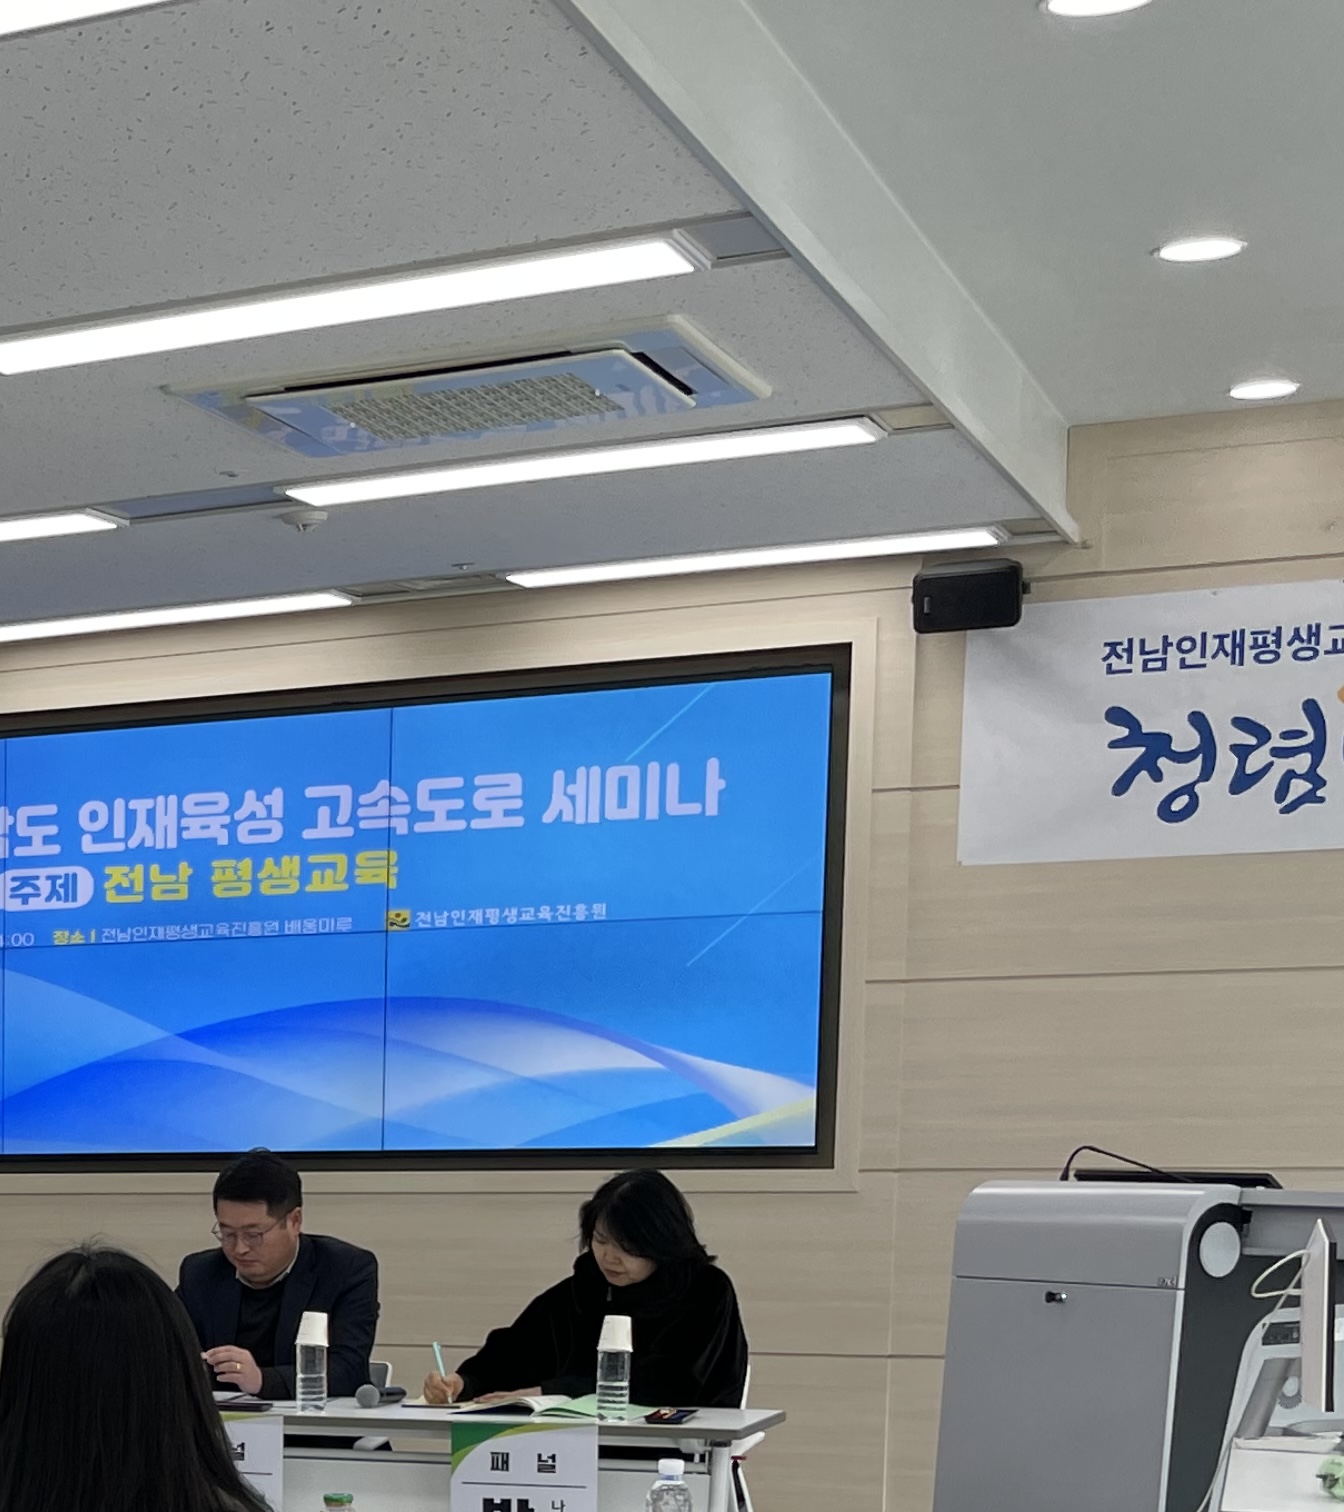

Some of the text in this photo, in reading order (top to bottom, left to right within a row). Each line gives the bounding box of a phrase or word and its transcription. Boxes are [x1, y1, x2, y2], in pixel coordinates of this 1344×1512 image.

[1104, 697, 1328, 824] 청렴
[77, 786, 285, 855] 인재육성
[301, 771, 526, 840] 고속도로
[541, 757, 727, 826] 세미나
[8, 850, 401, 905] 주제 전남 평생교육
[414, 902, 607, 929] 전남인재평생교육진흥원
